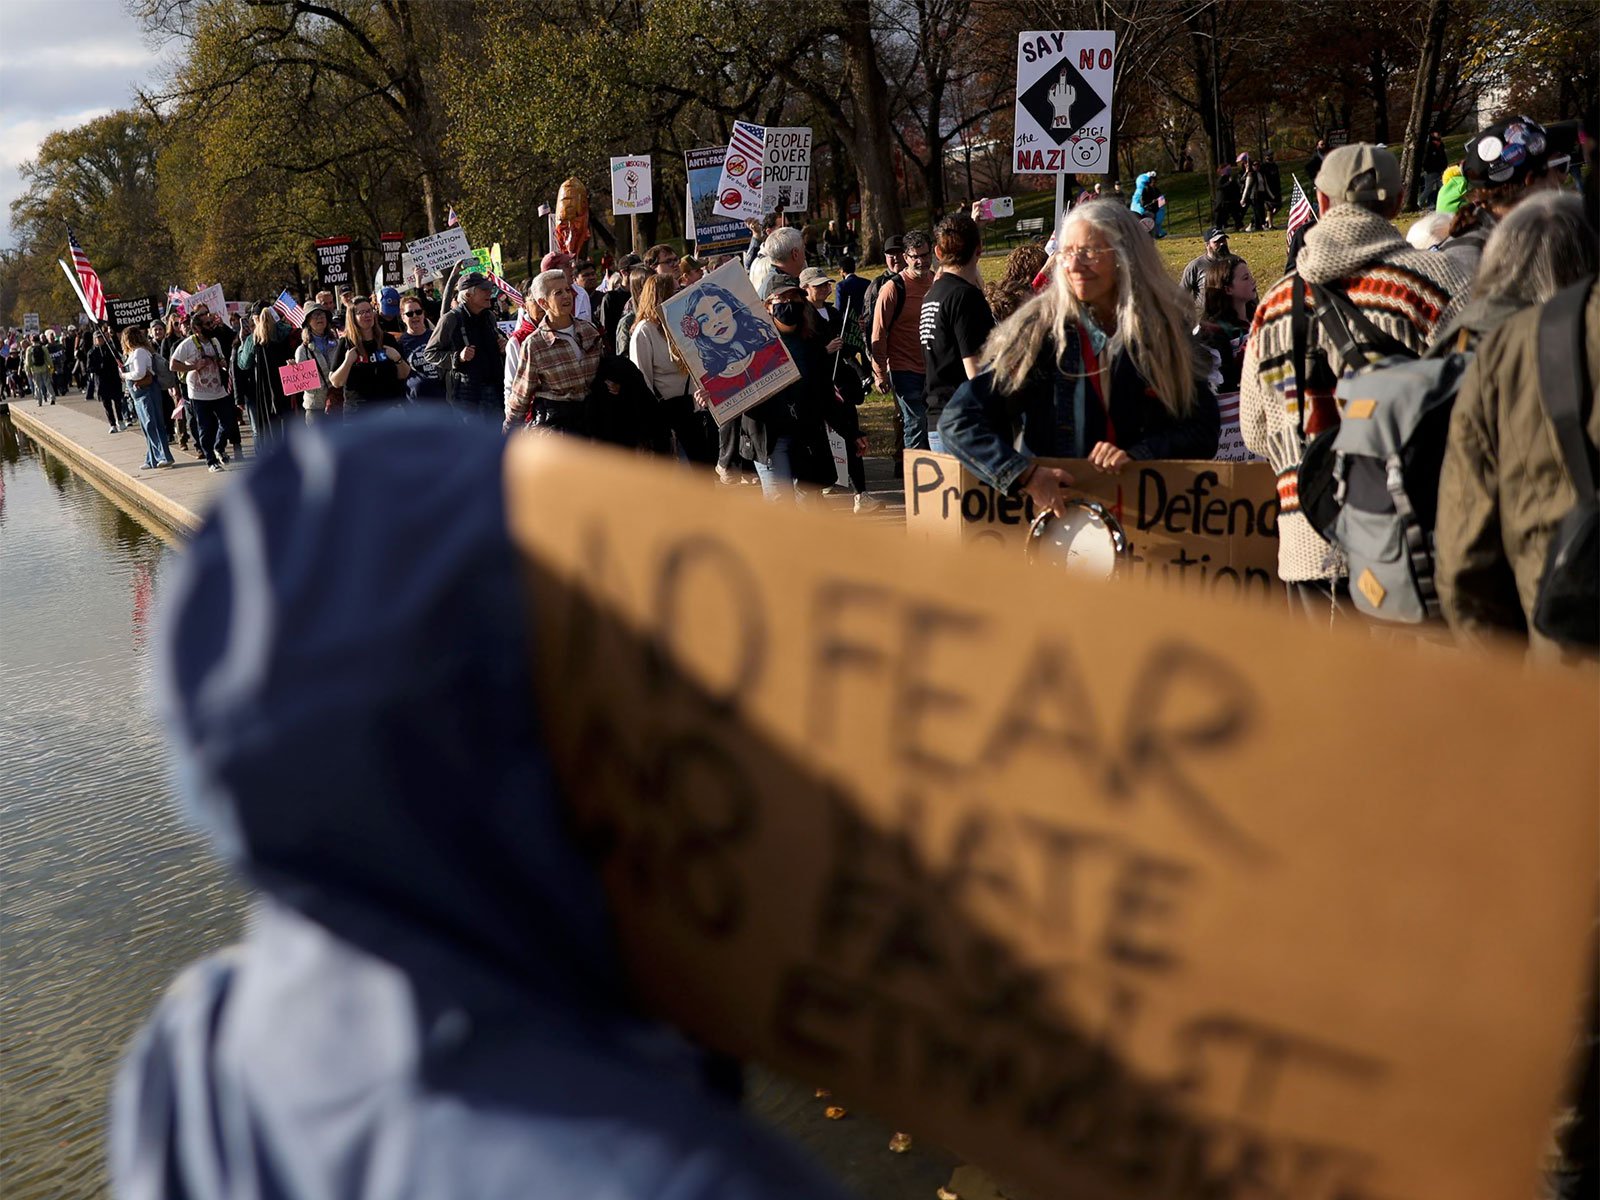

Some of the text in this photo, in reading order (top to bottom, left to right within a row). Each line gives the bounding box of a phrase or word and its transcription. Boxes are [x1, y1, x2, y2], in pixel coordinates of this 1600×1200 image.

[1022, 32, 1065, 63] SAY
[1079, 48, 1113, 70] NO
[1078, 126, 1104, 137] PIG!
[766, 133, 811, 149] PEOPLE
[1015, 133, 1039, 148] The
[769, 148, 806, 164] OVER
[1017, 149, 1066, 171] NAZI
[763, 165, 810, 182] PROFIT
[726, 174, 736, 182] We
[735, 180, 748, 191] beat
[696, 221, 731, 236] FIGHTING
[419, 236, 434, 245] HAVE
[712, 233, 725, 242] SINCE
[317, 245, 349, 256] TRUMP
[382, 241, 402, 252] TRUMP
[410, 234, 461, 255] CONSTITUTION
[385, 252, 400, 261] MUST
[426, 248, 448, 258] KINGS
[428, 249, 466, 266] OLIGARCHS
[321, 255, 347, 266] MUST
[431, 259, 455, 272] TRUMP
[328, 264, 341, 273] GO
[388, 262, 397, 272] GO
[324, 272, 348, 284] NOW!
[112, 298, 150, 310] IMPEACH
[114, 306, 151, 317] CONVICT
[116, 313, 153, 325] REMOVE
[292, 364, 305, 372] NO
[282, 370, 318, 385] FAUX KING
[294, 381, 311, 391] WAY
[724, 368, 784, 408] WE THE PEOPLE
[805, 578, 1284, 866] FEAR
[824, 780, 1210, 975] HATE
